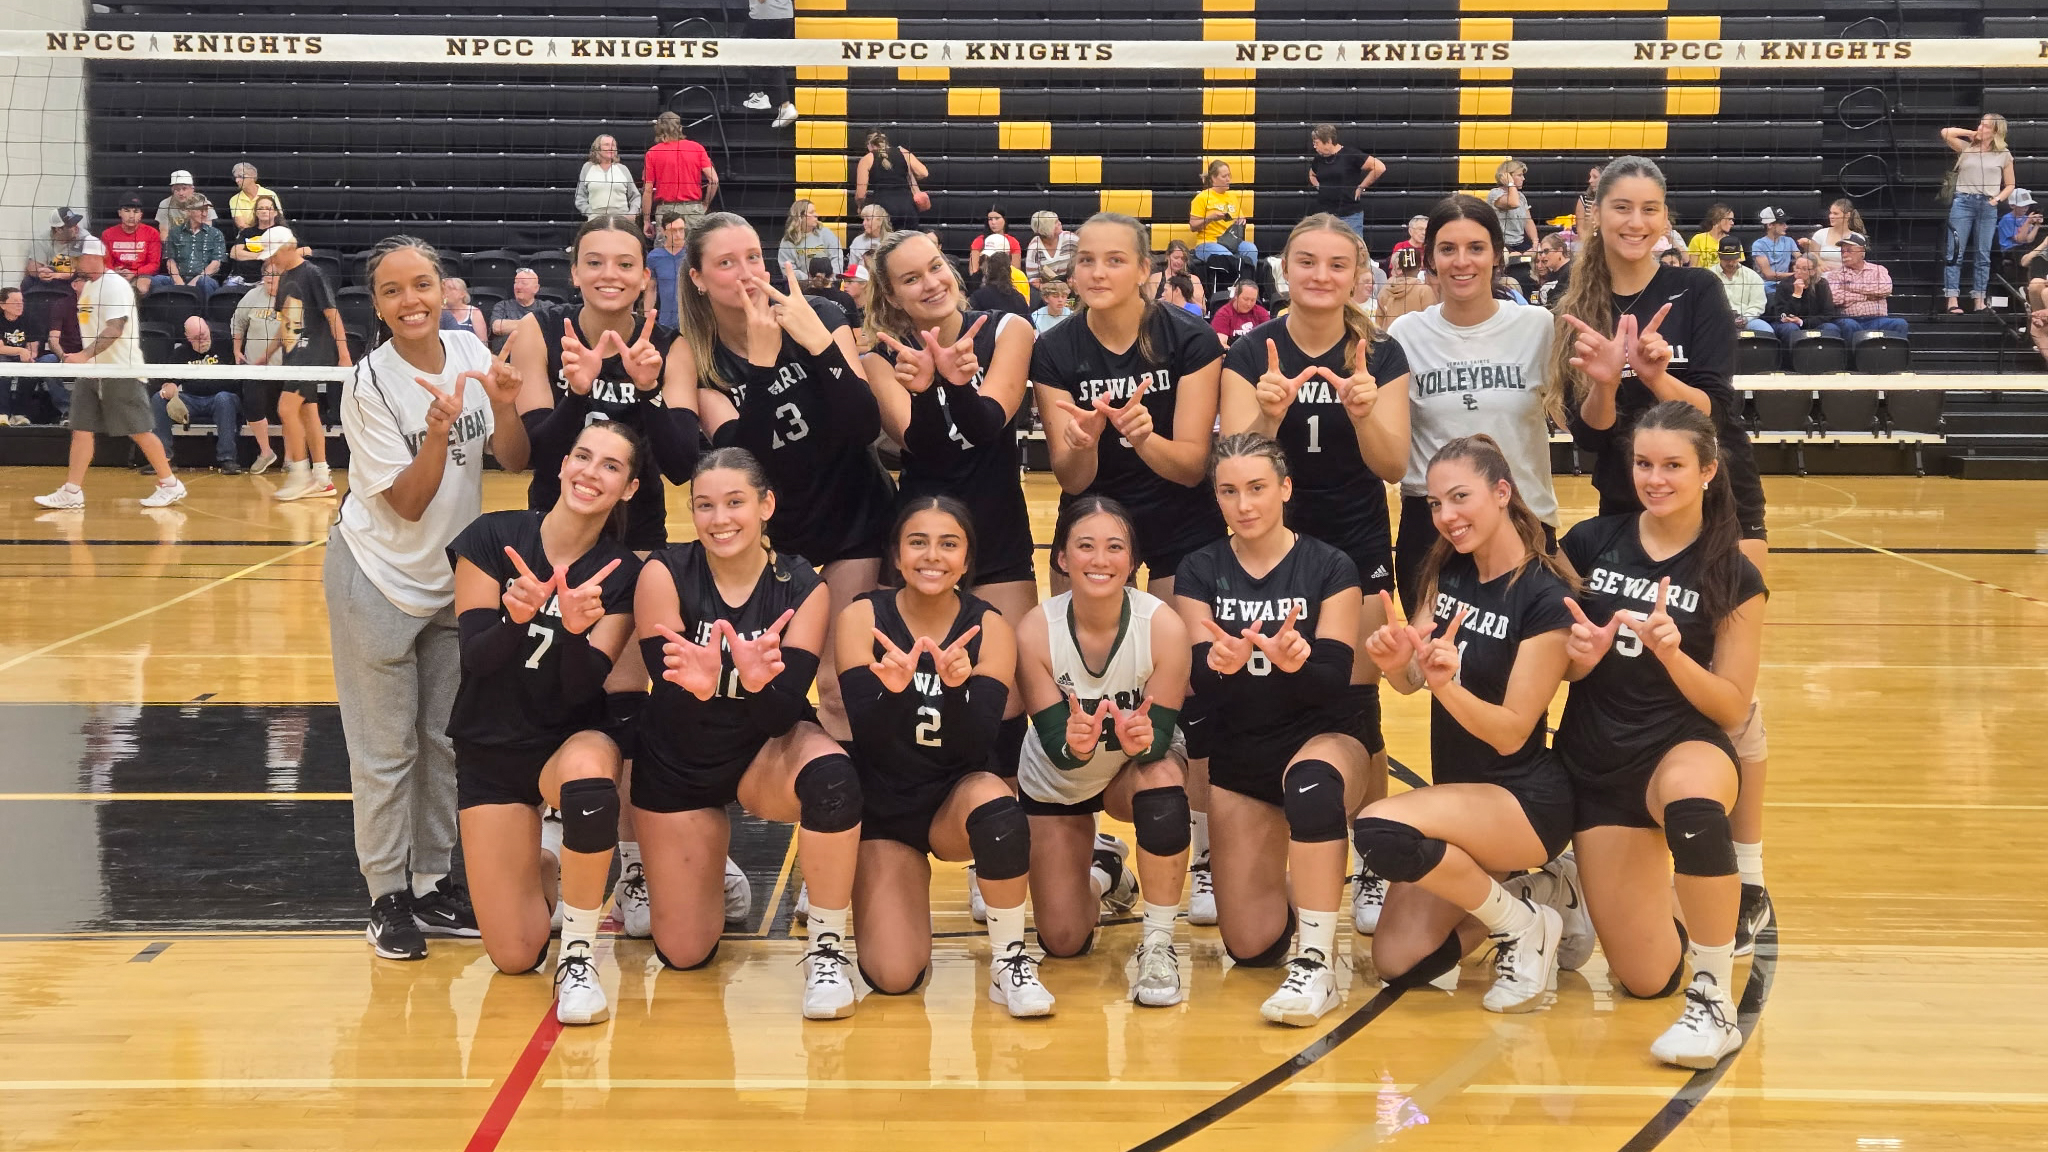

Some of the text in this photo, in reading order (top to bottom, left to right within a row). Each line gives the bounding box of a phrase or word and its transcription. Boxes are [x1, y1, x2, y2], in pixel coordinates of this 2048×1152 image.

[46, 32, 322, 54] NPCC KNIGHTS
[446, 36, 720, 58] NPCC KNIGHTS
[841, 41, 1114, 61] NPCC KNIGHTS
[1235, 42, 1511, 62] NPCC KNIGHTS
[1633, 41, 1912, 60] NPCC KNIGHTS
[1079, 369, 1171, 401] SEWARD
[1415, 365, 1526, 397] VOLLEYBALL
[1307, 415, 1322, 453] 1
[451, 448, 467, 467] SC
[1589, 567, 1700, 613] SEWARD
[1435, 593, 1509, 640] SEWARD
[524, 623, 554, 670] 7
[1615, 611, 1648, 658] 5
[915, 706, 942, 747] 2
